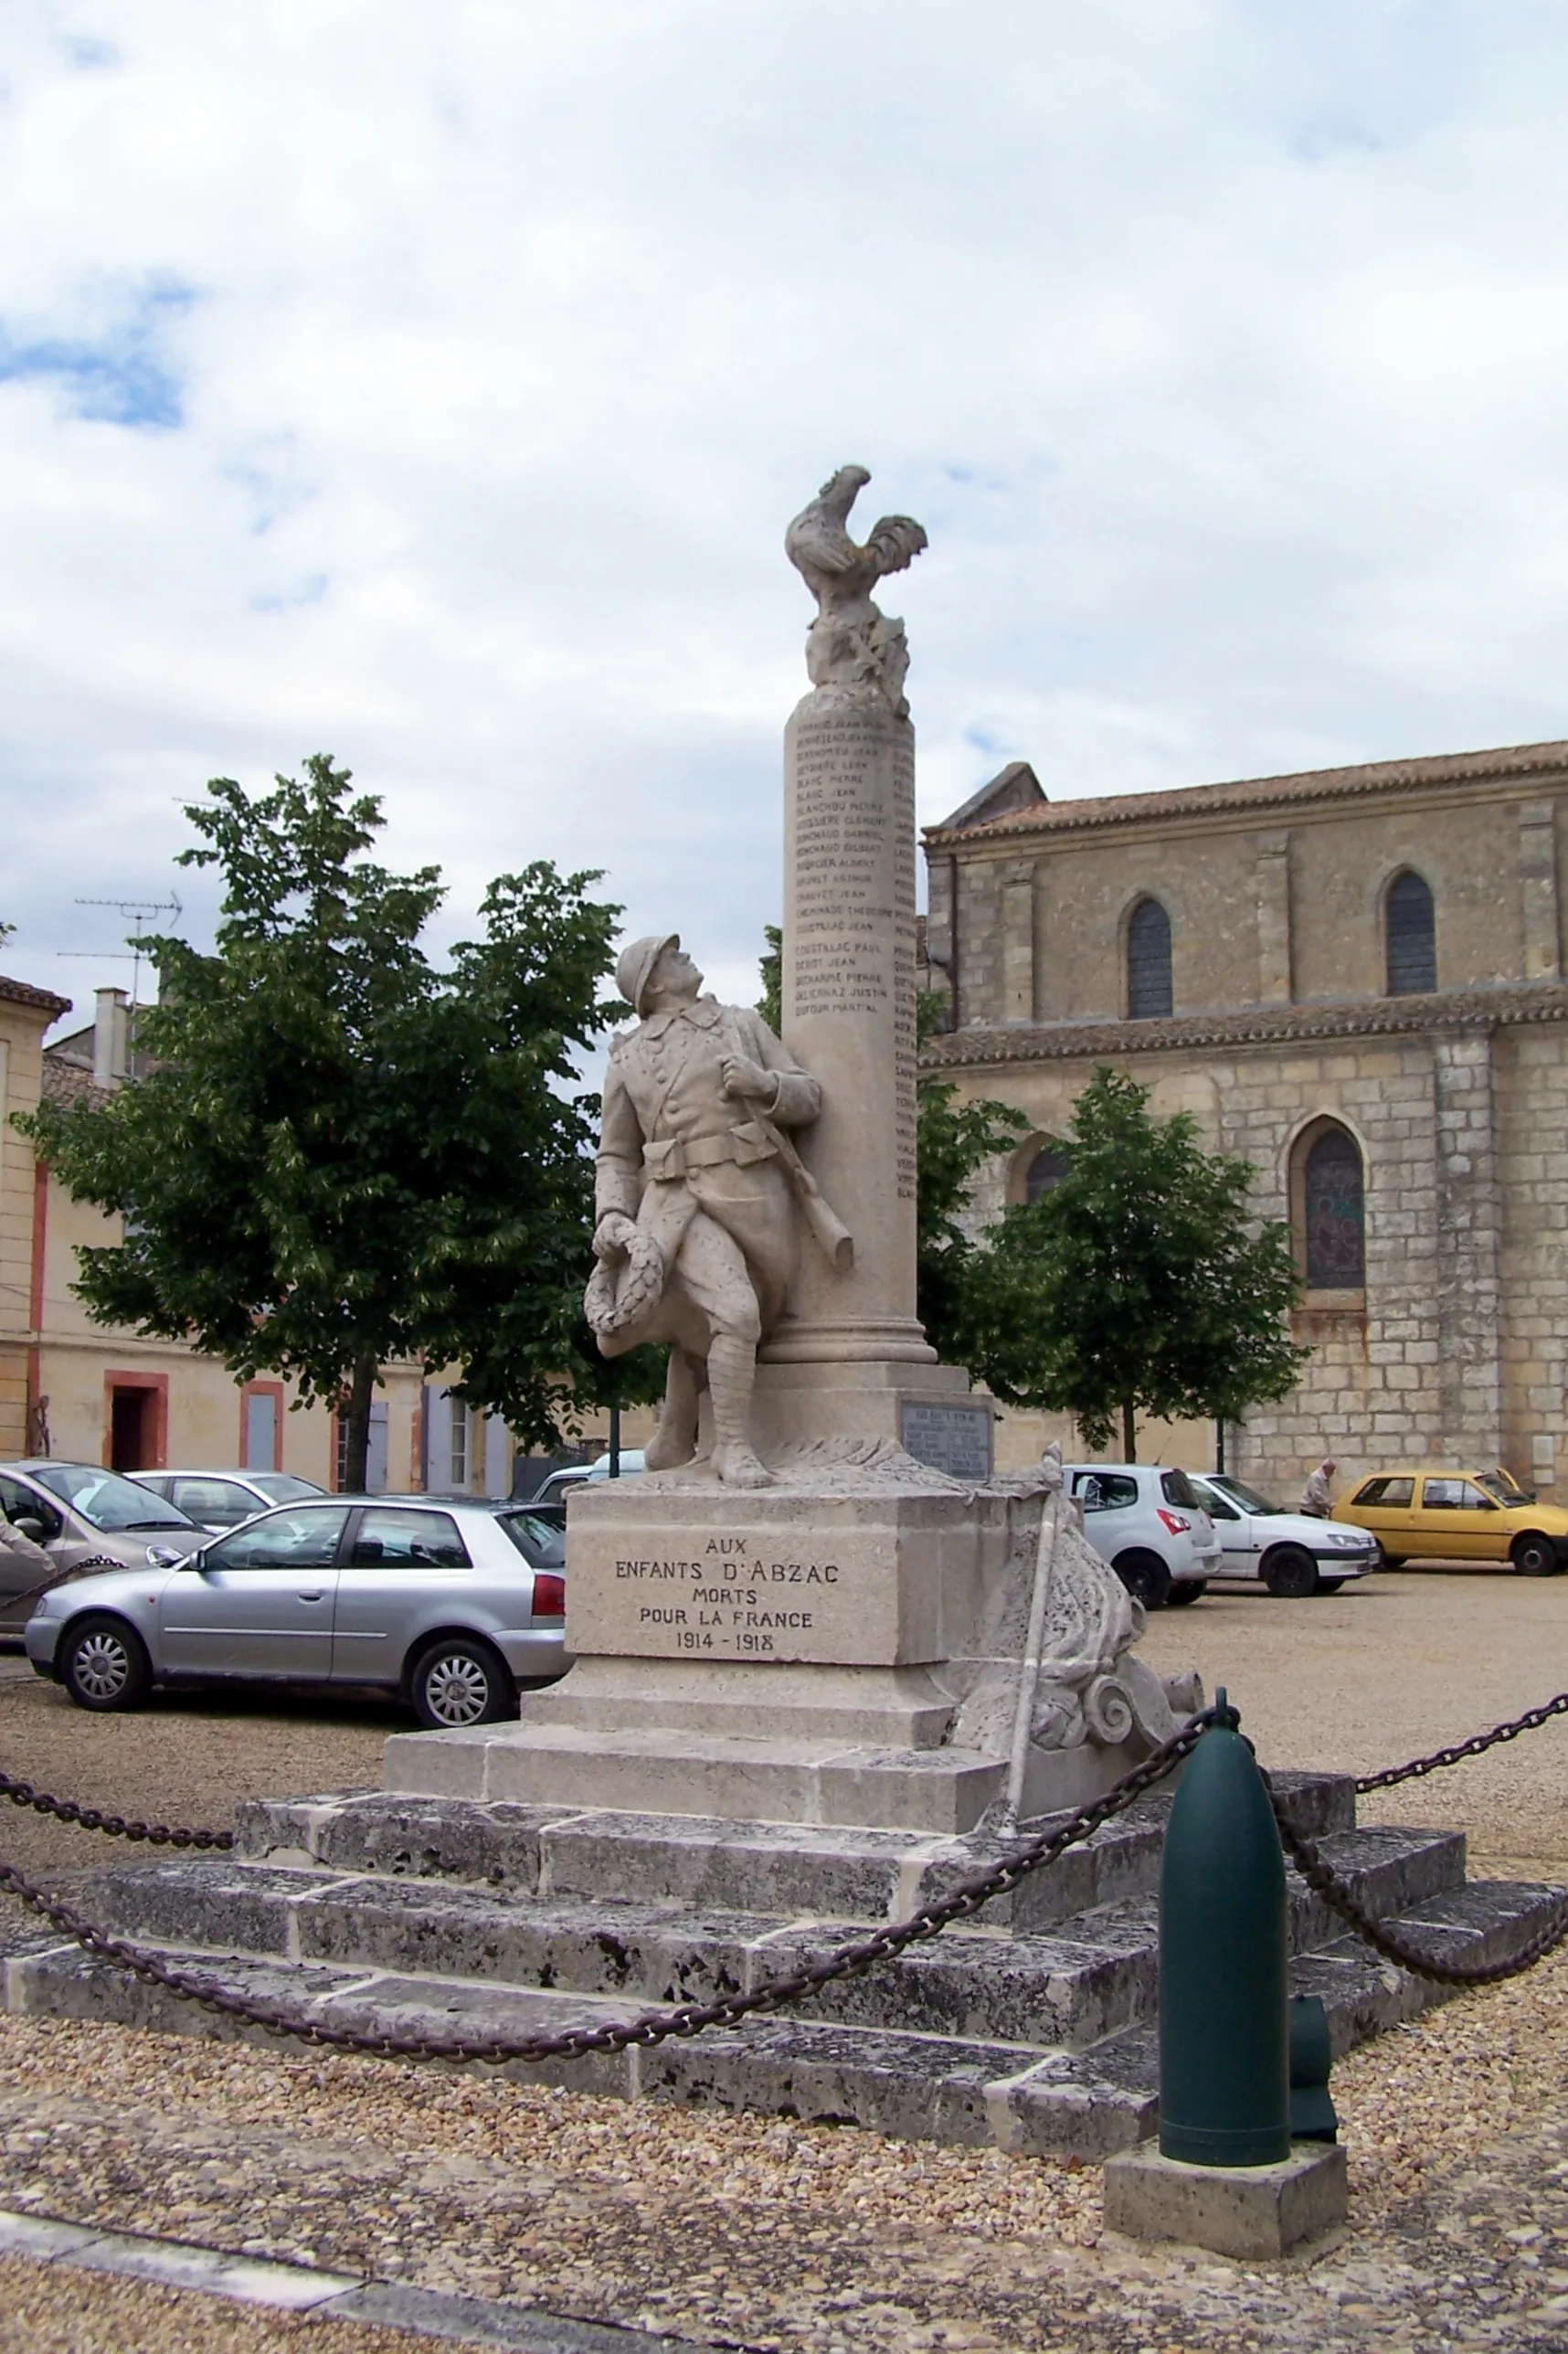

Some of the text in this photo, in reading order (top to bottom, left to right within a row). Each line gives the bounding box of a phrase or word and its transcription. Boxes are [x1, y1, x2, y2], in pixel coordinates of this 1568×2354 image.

[839, 889, 866, 899] JEAN
[848, 921, 874, 931] JEAN
[828, 958, 856, 968] JEAN
[849, 988, 888, 999] JUSTIN
[705, 1539, 747, 1553] AUX
[615, 1561, 703, 1580] ENFANTS
[693, 1588, 758, 1605] MORTS
[640, 1607, 812, 1628] POUR LA FRANCE
[677, 1632, 714, 1649] 1914
[736, 1634, 774, 1651] 1918
